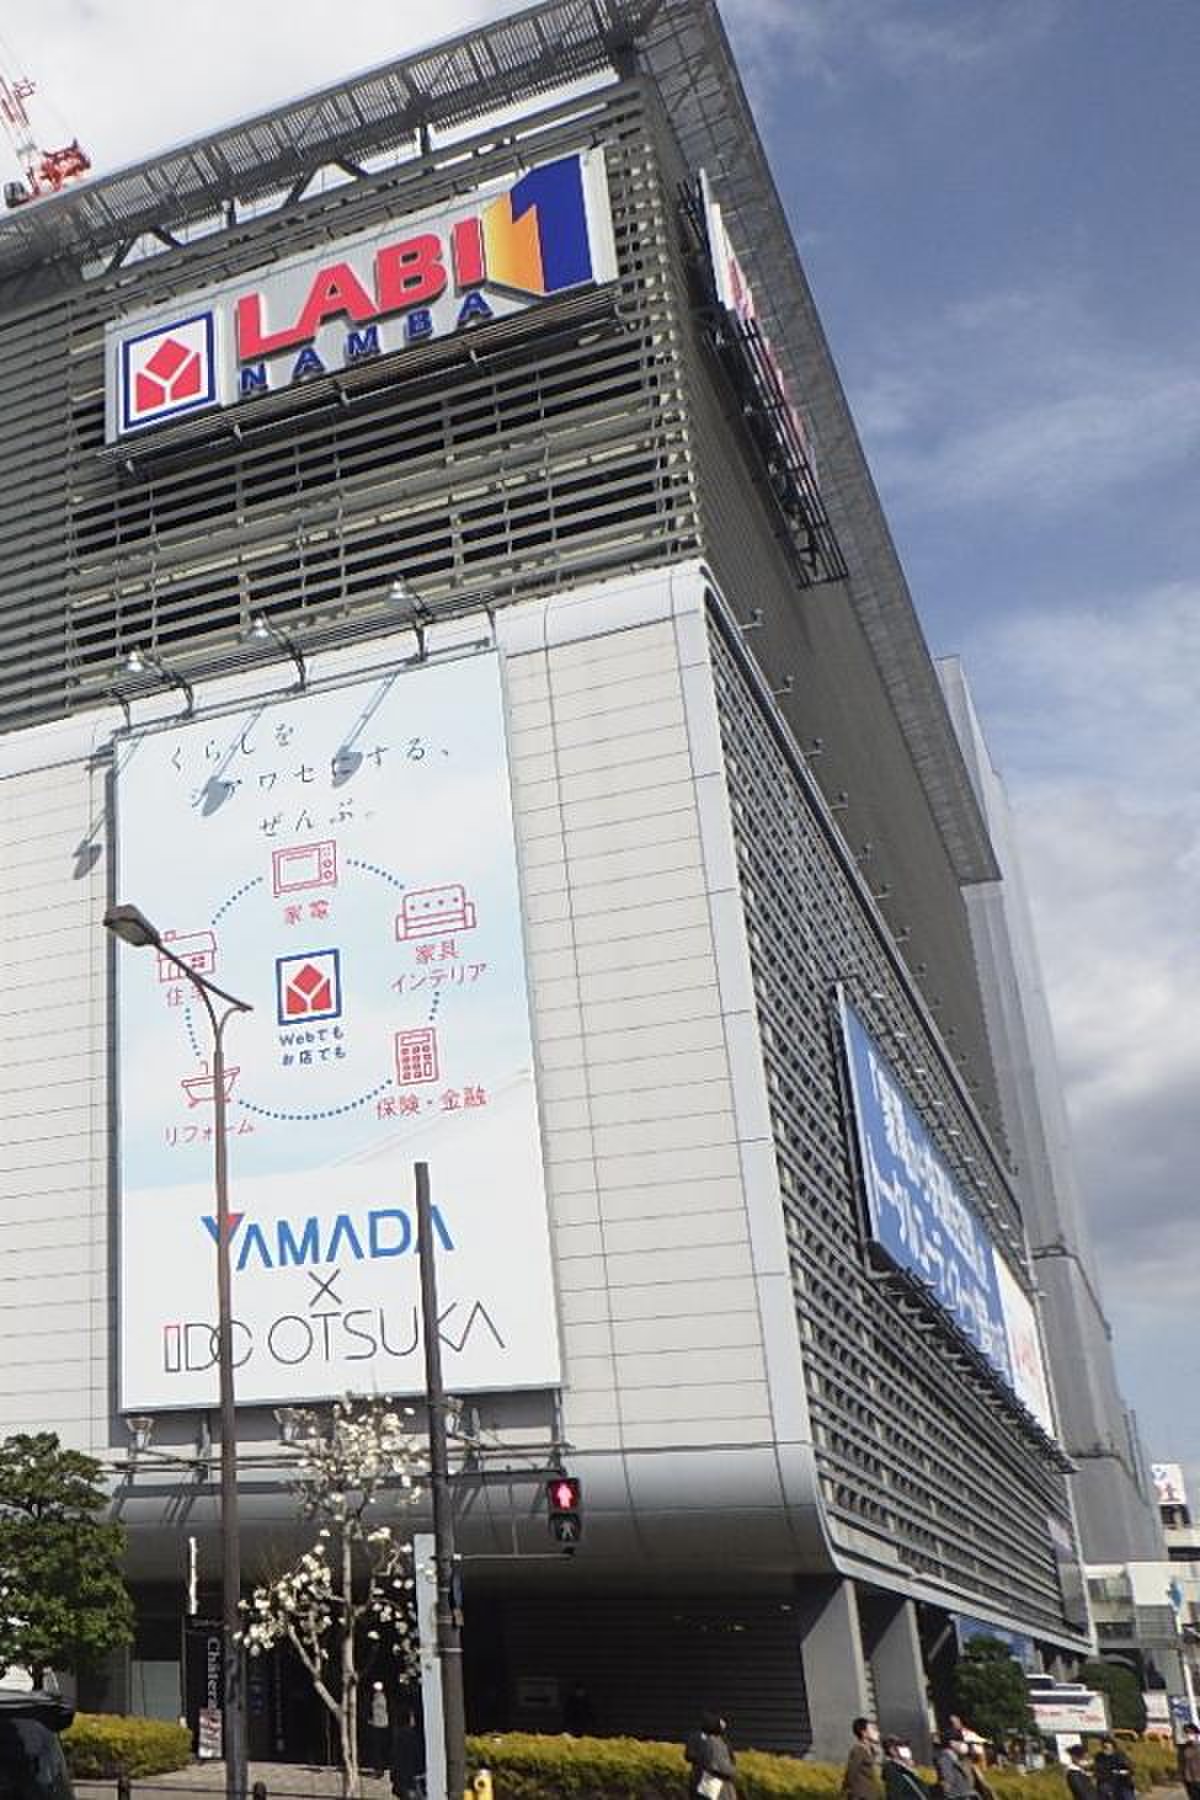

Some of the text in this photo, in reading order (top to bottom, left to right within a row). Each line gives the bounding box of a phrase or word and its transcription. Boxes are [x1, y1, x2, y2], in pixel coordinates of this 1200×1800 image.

[240, 289, 495, 393] NAMBA
[415, 939, 459, 964] 家具
[391, 963, 487, 992] インテリア
[279, 1026, 345, 1047] Webでも
[282, 1047, 346, 1067] お店でも
